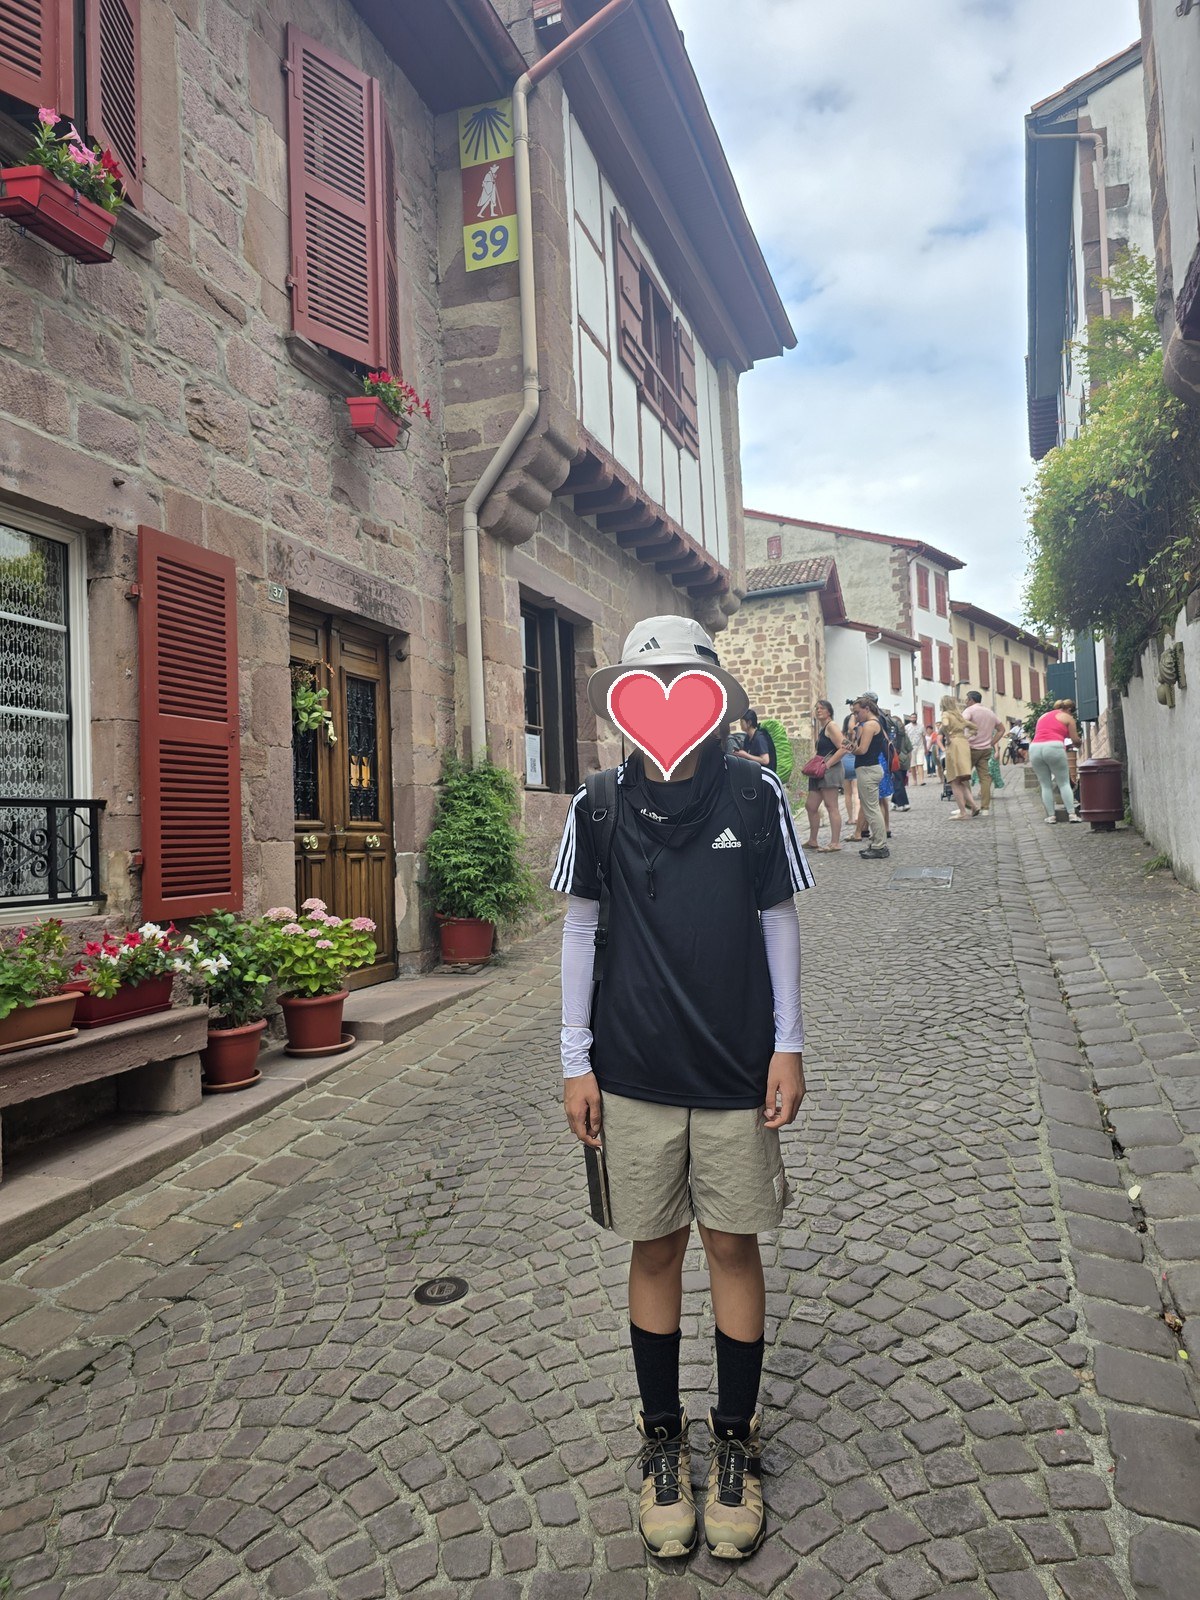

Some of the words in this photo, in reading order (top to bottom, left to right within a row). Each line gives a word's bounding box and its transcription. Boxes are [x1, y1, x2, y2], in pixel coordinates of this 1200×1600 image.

[471, 225, 509, 261] 39
[272, 587, 283, 599] 37
[711, 840, 742, 849] adidas
